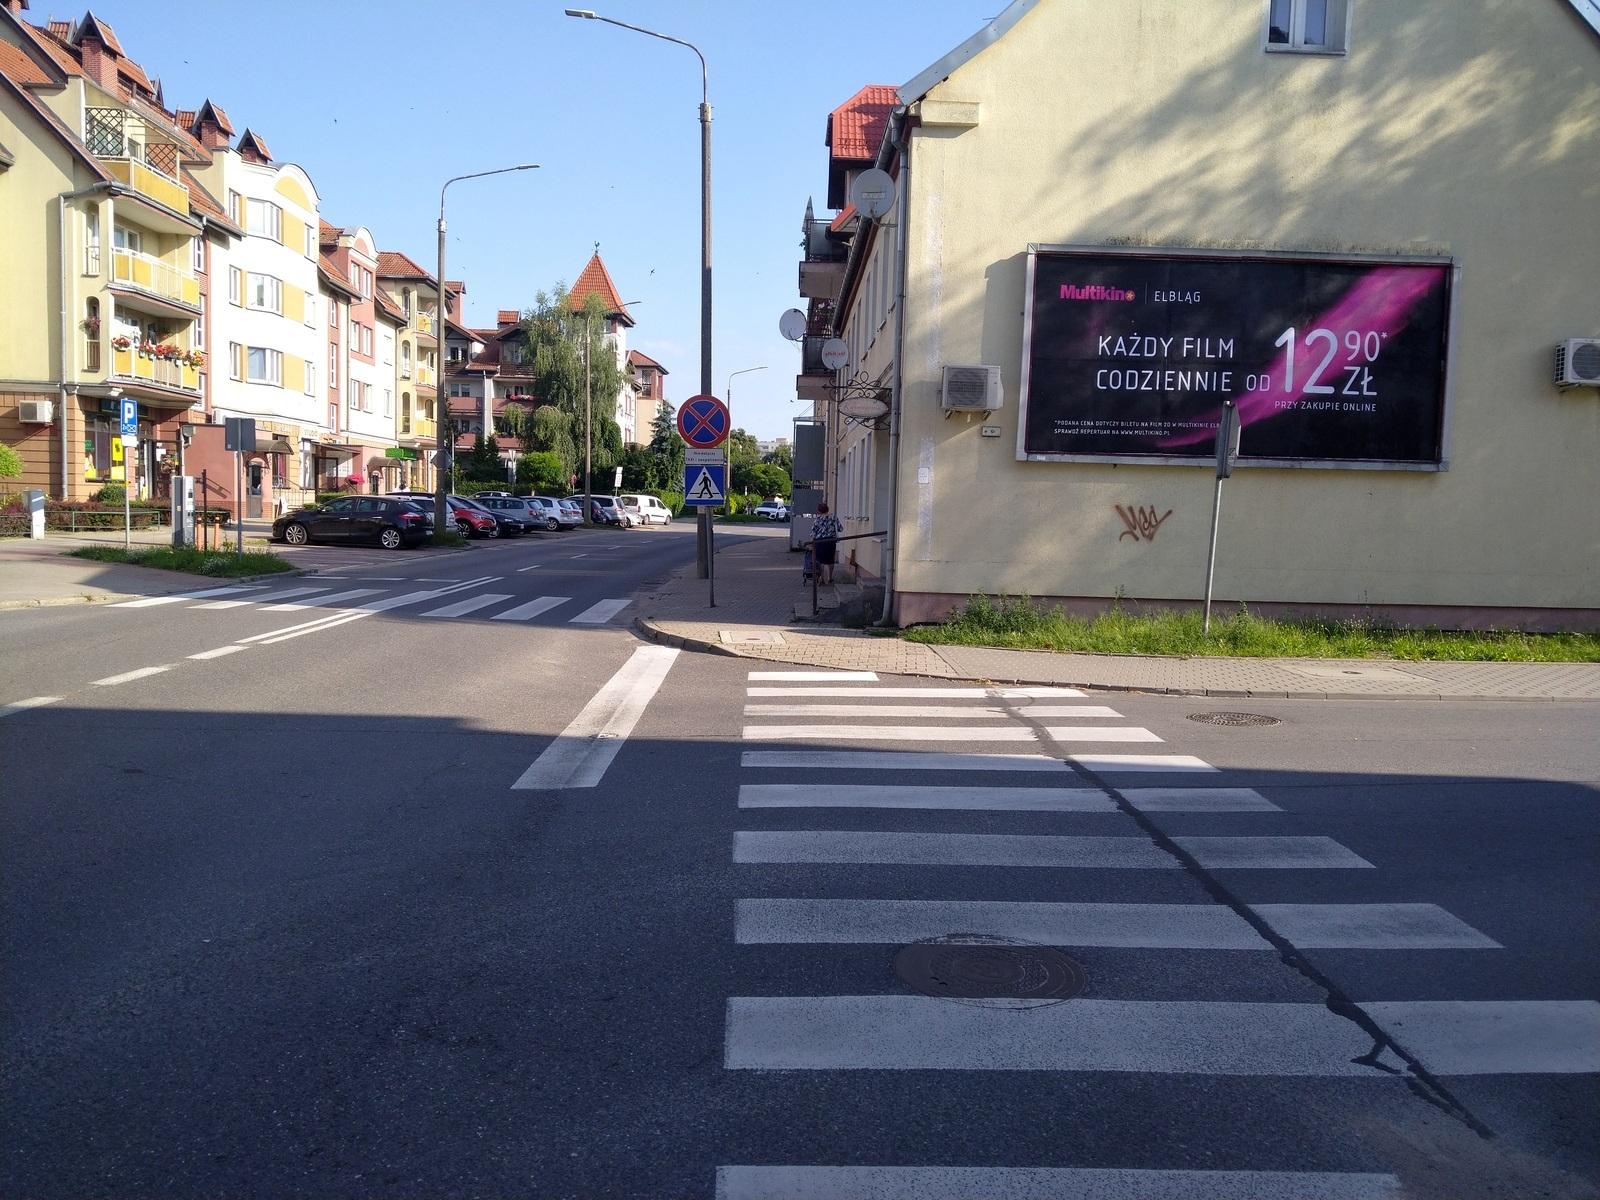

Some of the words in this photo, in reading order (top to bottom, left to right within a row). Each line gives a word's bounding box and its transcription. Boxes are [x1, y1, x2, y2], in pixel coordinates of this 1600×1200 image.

[1060, 284, 1136, 301] Multikino
[1154, 290, 1201, 304] ELBLĄG
[1097, 332, 1174, 358] KAŻDY
[1183, 337, 1234, 358] FILM
[1096, 369, 1233, 392] CODZIENNIE
[1246, 374, 1271, 392] OD
[1274, 326, 1338, 394] 12
[1342, 366, 1378, 396] ZŁ
[124, 402, 135, 424] P
[1274, 400, 1299, 410] PRZY
[1301, 401, 1341, 411] ZAKUPIE
[1343, 402, 1377, 412] ONLINE
